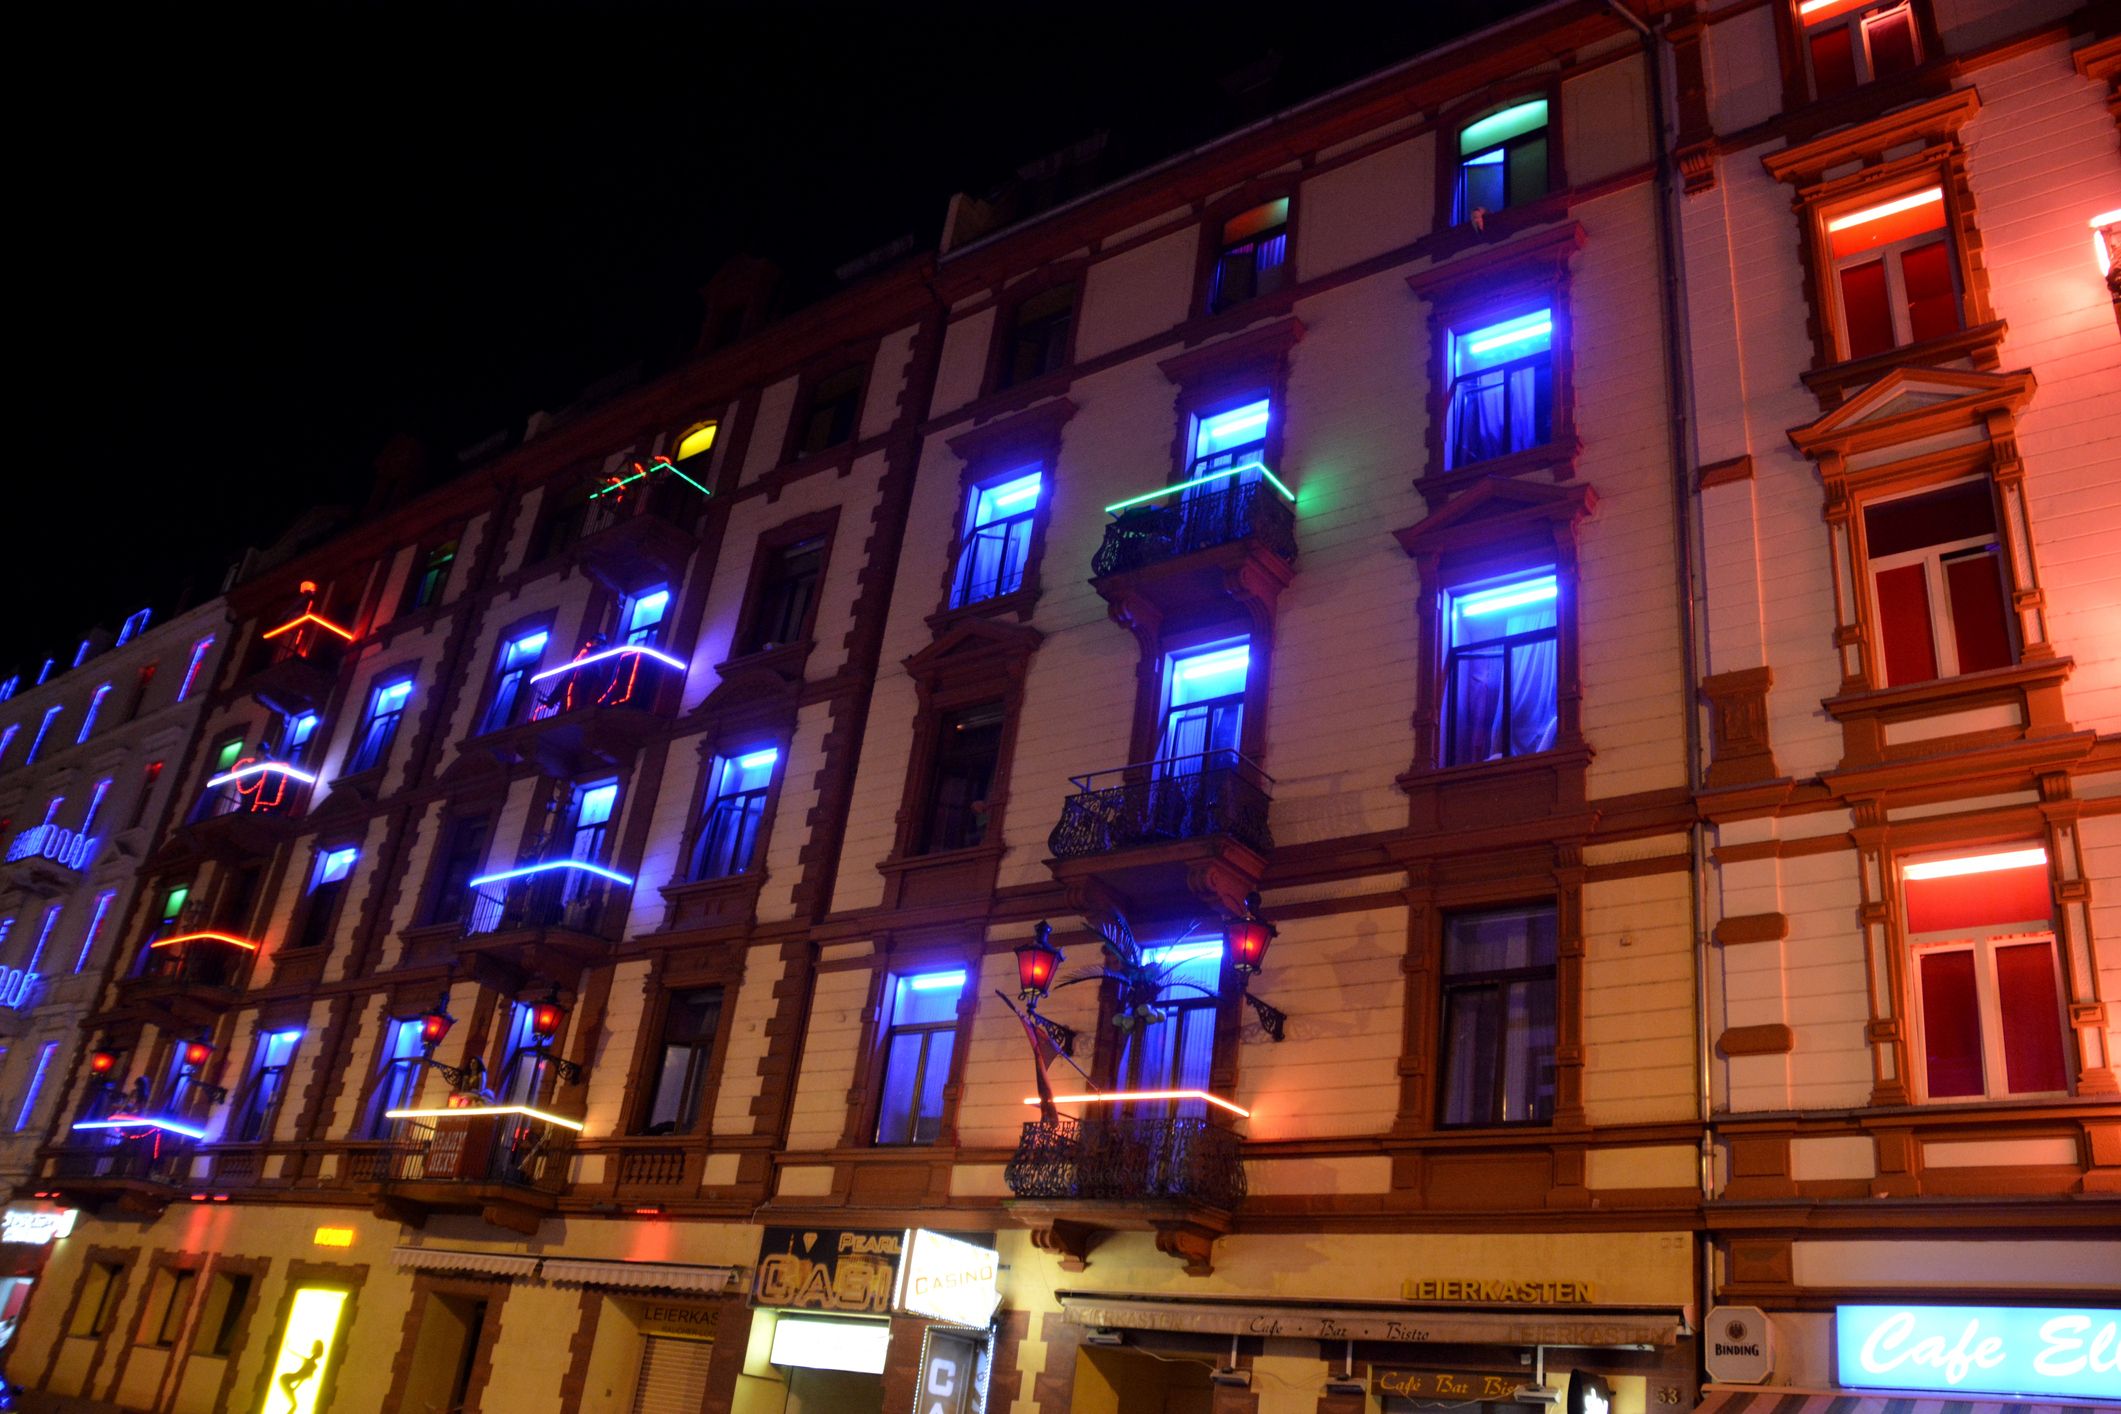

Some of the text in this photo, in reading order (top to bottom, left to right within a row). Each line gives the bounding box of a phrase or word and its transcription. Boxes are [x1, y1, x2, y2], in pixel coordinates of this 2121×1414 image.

[838, 1232, 902, 1254] PEARL
[757, 1253, 893, 1312] CASI
[914, 1265, 994, 1297] CASINO
[1402, 1278, 1595, 1304] LEIERKASTEN
[1319, 1319, 1348, 1338] Bar
[1387, 1321, 1430, 1341] Bistro
[1715, 1343, 1760, 1357] BINDING
[1859, 1310, 2121, 1386] Cafe El
[1435, 1373, 1471, 1394] Bar
